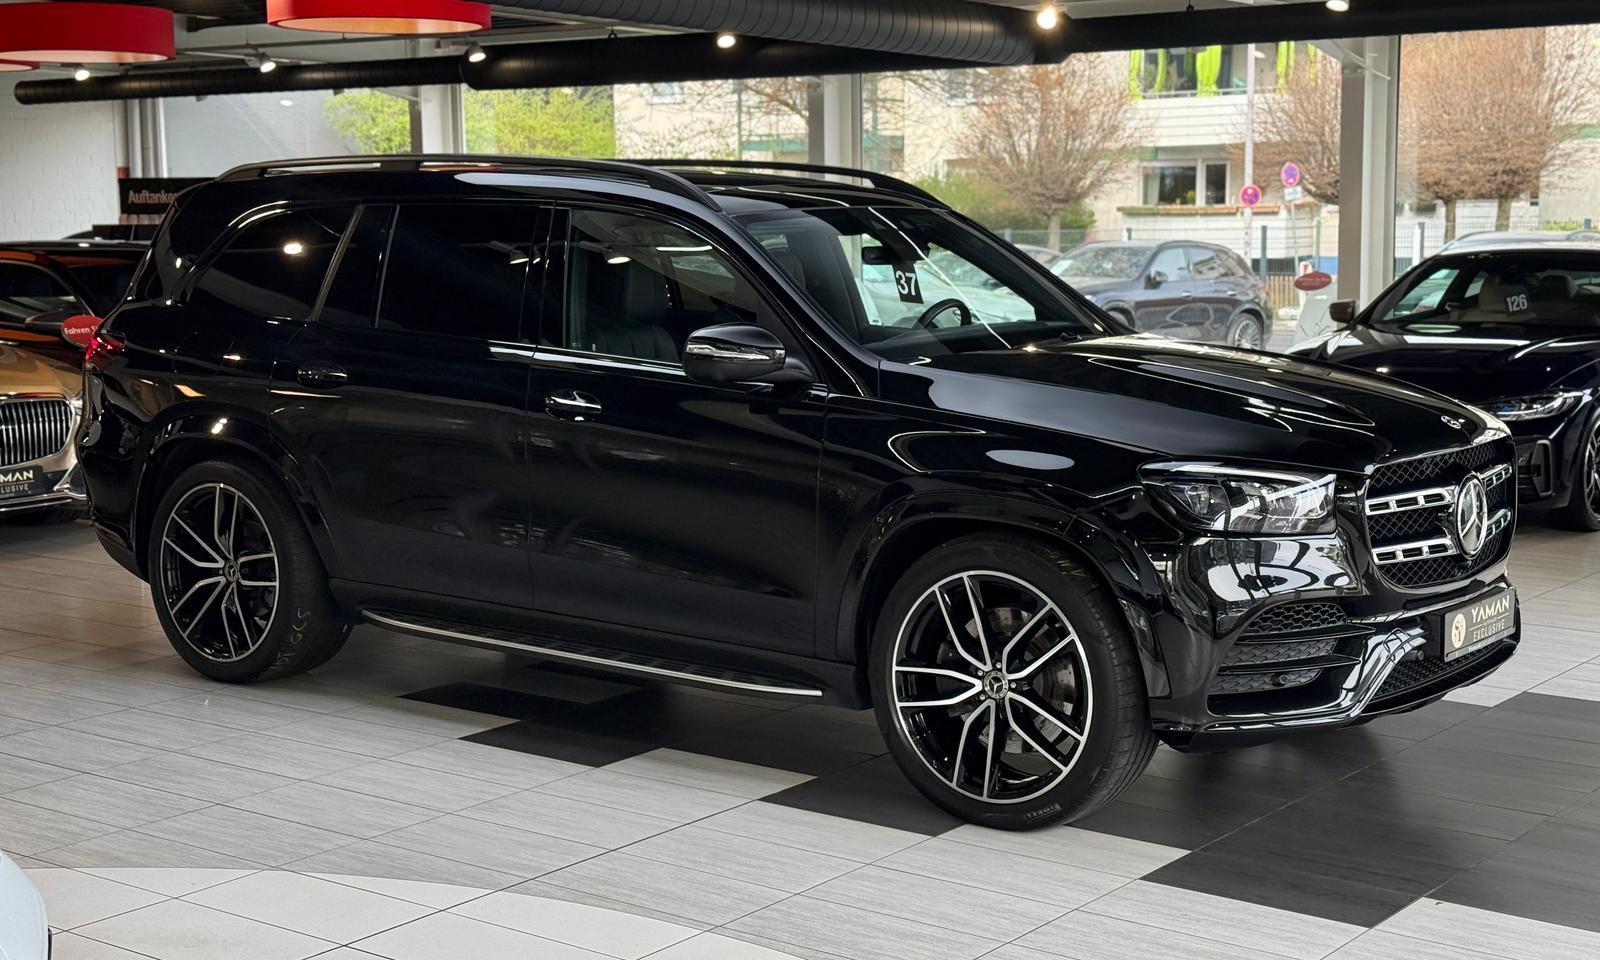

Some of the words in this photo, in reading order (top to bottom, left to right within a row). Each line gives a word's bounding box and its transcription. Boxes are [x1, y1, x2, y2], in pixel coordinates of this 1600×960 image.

[896, 270, 916, 296] 37
[1506, 294, 1528, 312] 126
[64, 327, 91, 335] Fahren
[1471, 595, 1510, 624] YAMAN
